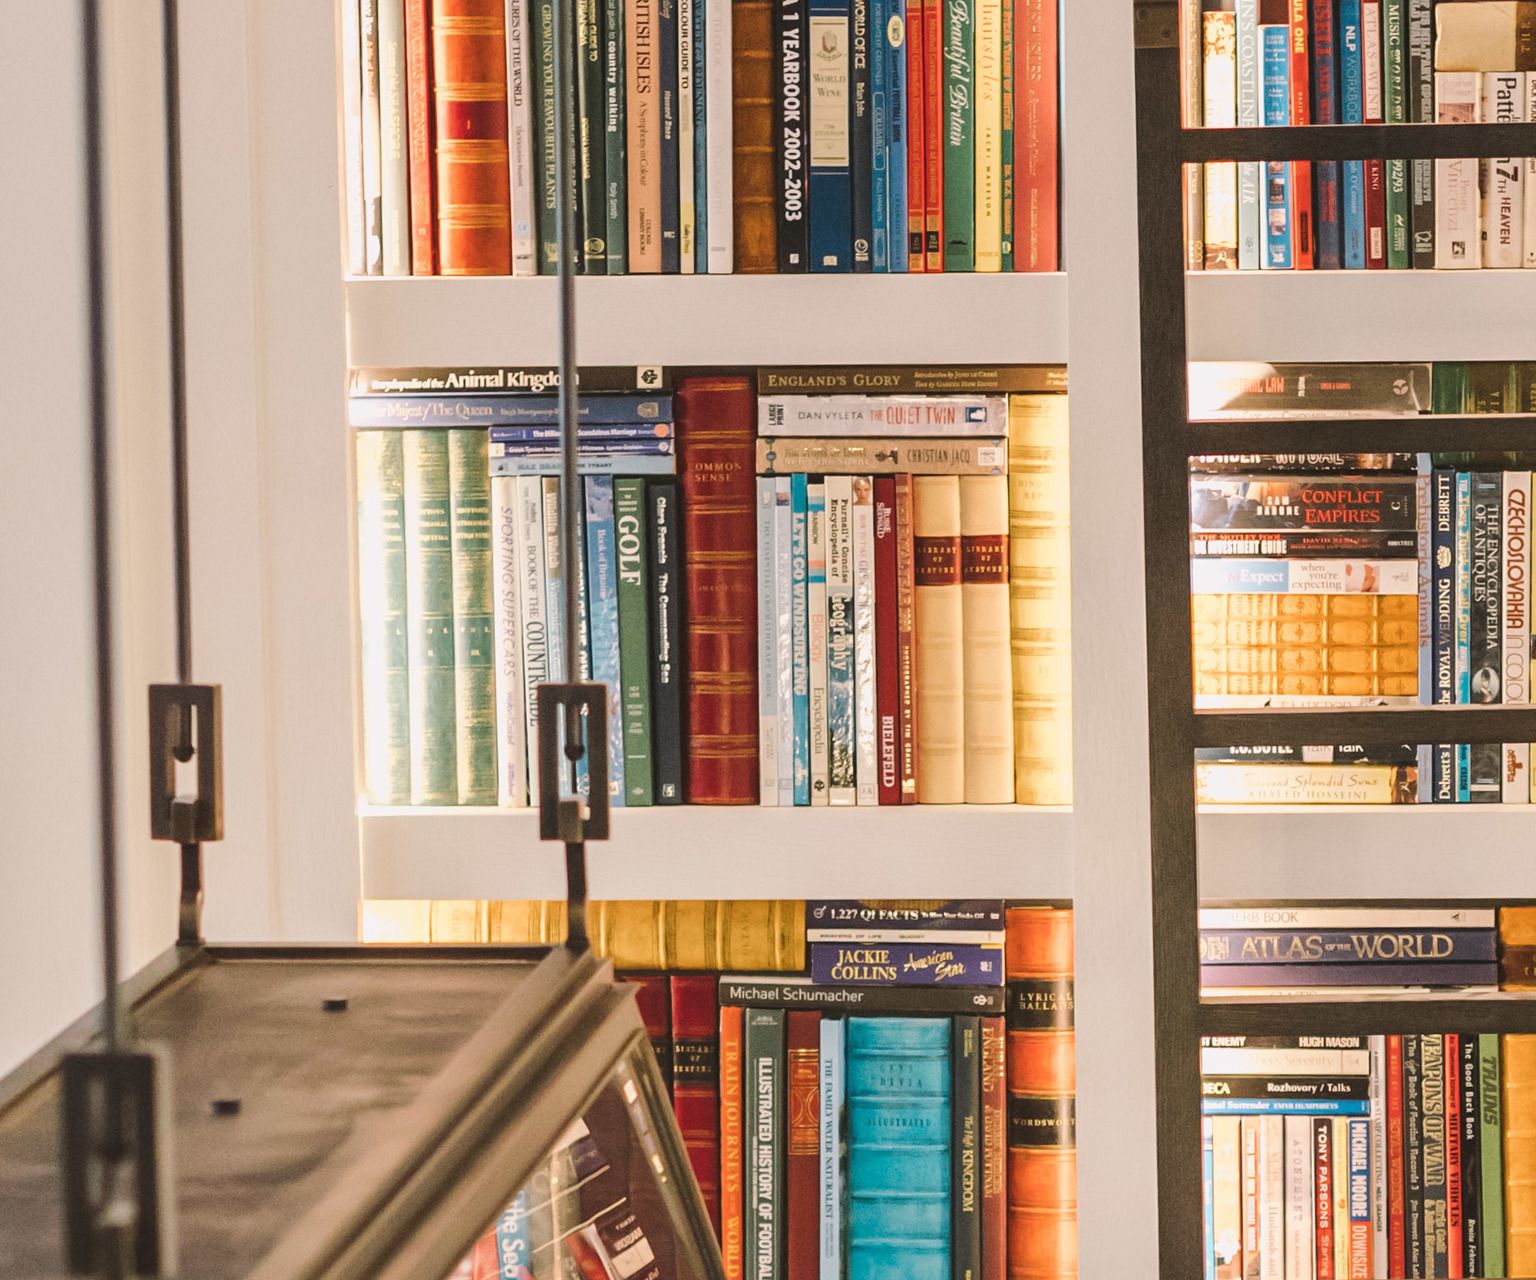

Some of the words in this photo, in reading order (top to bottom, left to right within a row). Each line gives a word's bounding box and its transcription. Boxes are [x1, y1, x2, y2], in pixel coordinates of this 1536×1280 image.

[542, 5, 552, 61] GROWING
[606, 10, 617, 31] guide
[945, 1, 971, 78] Beautiful
[1293, 27, 1304, 53] ONE
[1345, 26, 1355, 51] NLP
[1366, 6, 1377, 61] ATLAS
[1389, 5, 1399, 45] MUSIC
[607, 41, 617, 83] country
[978, 4, 999, 101] hairstyles
[543, 64, 553, 95] YOUR
[783, 28, 800, 123] YEARBOOK
[813, 74, 846, 83] WORLD
[1367, 72, 1379, 116] WINE
[608, 87, 617, 132] walking
[949, 85, 968, 145] Britain
[545, 98, 555, 162] FAVOURITE
[546, 164, 556, 208] PLANTS
[610, 182, 618, 197] Roly
[1371, 168, 1379, 190] KING
[1448, 160, 1463, 230] Vincenzi
[610, 198, 618, 219] Smith
[768, 374, 847, 388] ENGLAND'S
[854, 374, 902, 387] GLORY
[870, 411, 884, 422] THE
[886, 408, 921, 425] QUIET
[1301, 491, 1383, 504] CONFLICT
[1304, 510, 1380, 524] EMPIRES
[1474, 504, 1486, 524] OF
[1487, 505, 1498, 536] THE
[500, 507, 513, 588] SPORTING
[527, 545, 538, 577] BOOK
[618, 515, 641, 586] GOLF
[1301, 563, 1326, 571] when
[1474, 528, 1486, 602] ANTIQUES
[1507, 489, 1525, 629] CZECHOSLOVAKIA
[528, 579, 539, 594] OF
[1240, 570, 1284, 585] Expect
[1291, 581, 1342, 591] expecting
[1487, 539, 1498, 649] ENCYCLOPEDIA
[529, 597, 539, 618] THE
[502, 591, 515, 678] SUPERCARS
[811, 614, 825, 663] Biology
[828, 592, 851, 671] Geography
[812, 687, 825, 754] Encyclopedia
[882, 715, 894, 787] BIELEFELD
[837, 950, 890, 965] JACKIE
[1242, 934, 1323, 959] ATLAS
[1351, 934, 1454, 958] WORLD
[832, 965, 897, 979] COLLINS
[730, 987, 780, 1000] Michael
[783, 988, 864, 1004] Schumacher
[1299, 1037, 1324, 1048] HUGH
[1326, 1037, 1360, 1048] MASON
[1465, 1043, 1474, 1059] The
[726, 1040, 740, 1096] TRAIN
[824, 1058, 833, 1079] THE
[1465, 1063, 1474, 1089] Good
[758, 1058, 773, 1142] ILLUSTRATED
[824, 1082, 833, 1117] FAMILY
[1465, 1092, 1475, 1113] Back
[1483, 1056, 1497, 1126] TRAINS
[726, 1099, 740, 1193] JOURNEYS
[824, 1120, 833, 1153] WATER
[1318, 1126, 1328, 1161] TONY
[1352, 1122, 1366, 1172] MICHAEL
[1424, 1115, 1444, 1140] OF
[1465, 1117, 1475, 1140] Book
[758, 1144, 773, 1200] HISTORY
[1293, 1139, 1303, 1222] ATONEMENT
[1424, 1144, 1444, 1188] WAR
[824, 1156, 833, 1218] NATURALIST
[1318, 1166, 1328, 1229] PARSONS
[1352, 1174, 1366, 1217] MOORE
[759, 1202, 773, 1220] OF
[727, 1216, 740, 1278] WORLD
[1318, 1234, 1329, 1277] Starting
[1352, 1225, 1367, 1279] DOWNSIZE
